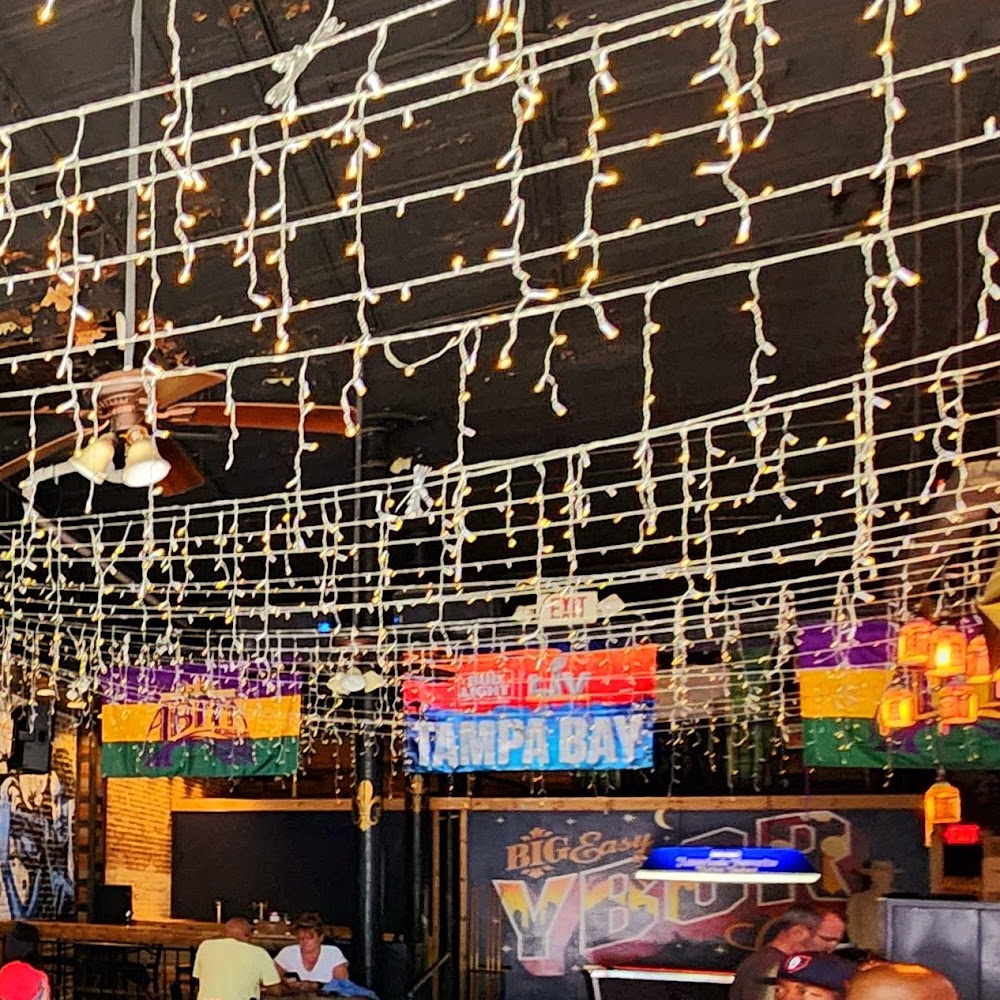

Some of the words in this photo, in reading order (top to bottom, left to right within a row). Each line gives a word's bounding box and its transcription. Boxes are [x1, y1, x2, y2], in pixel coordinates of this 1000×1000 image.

[416, 717, 549, 769] TAMPA
[558, 712, 644, 764] BAY
[505, 836, 570, 871] BIG
